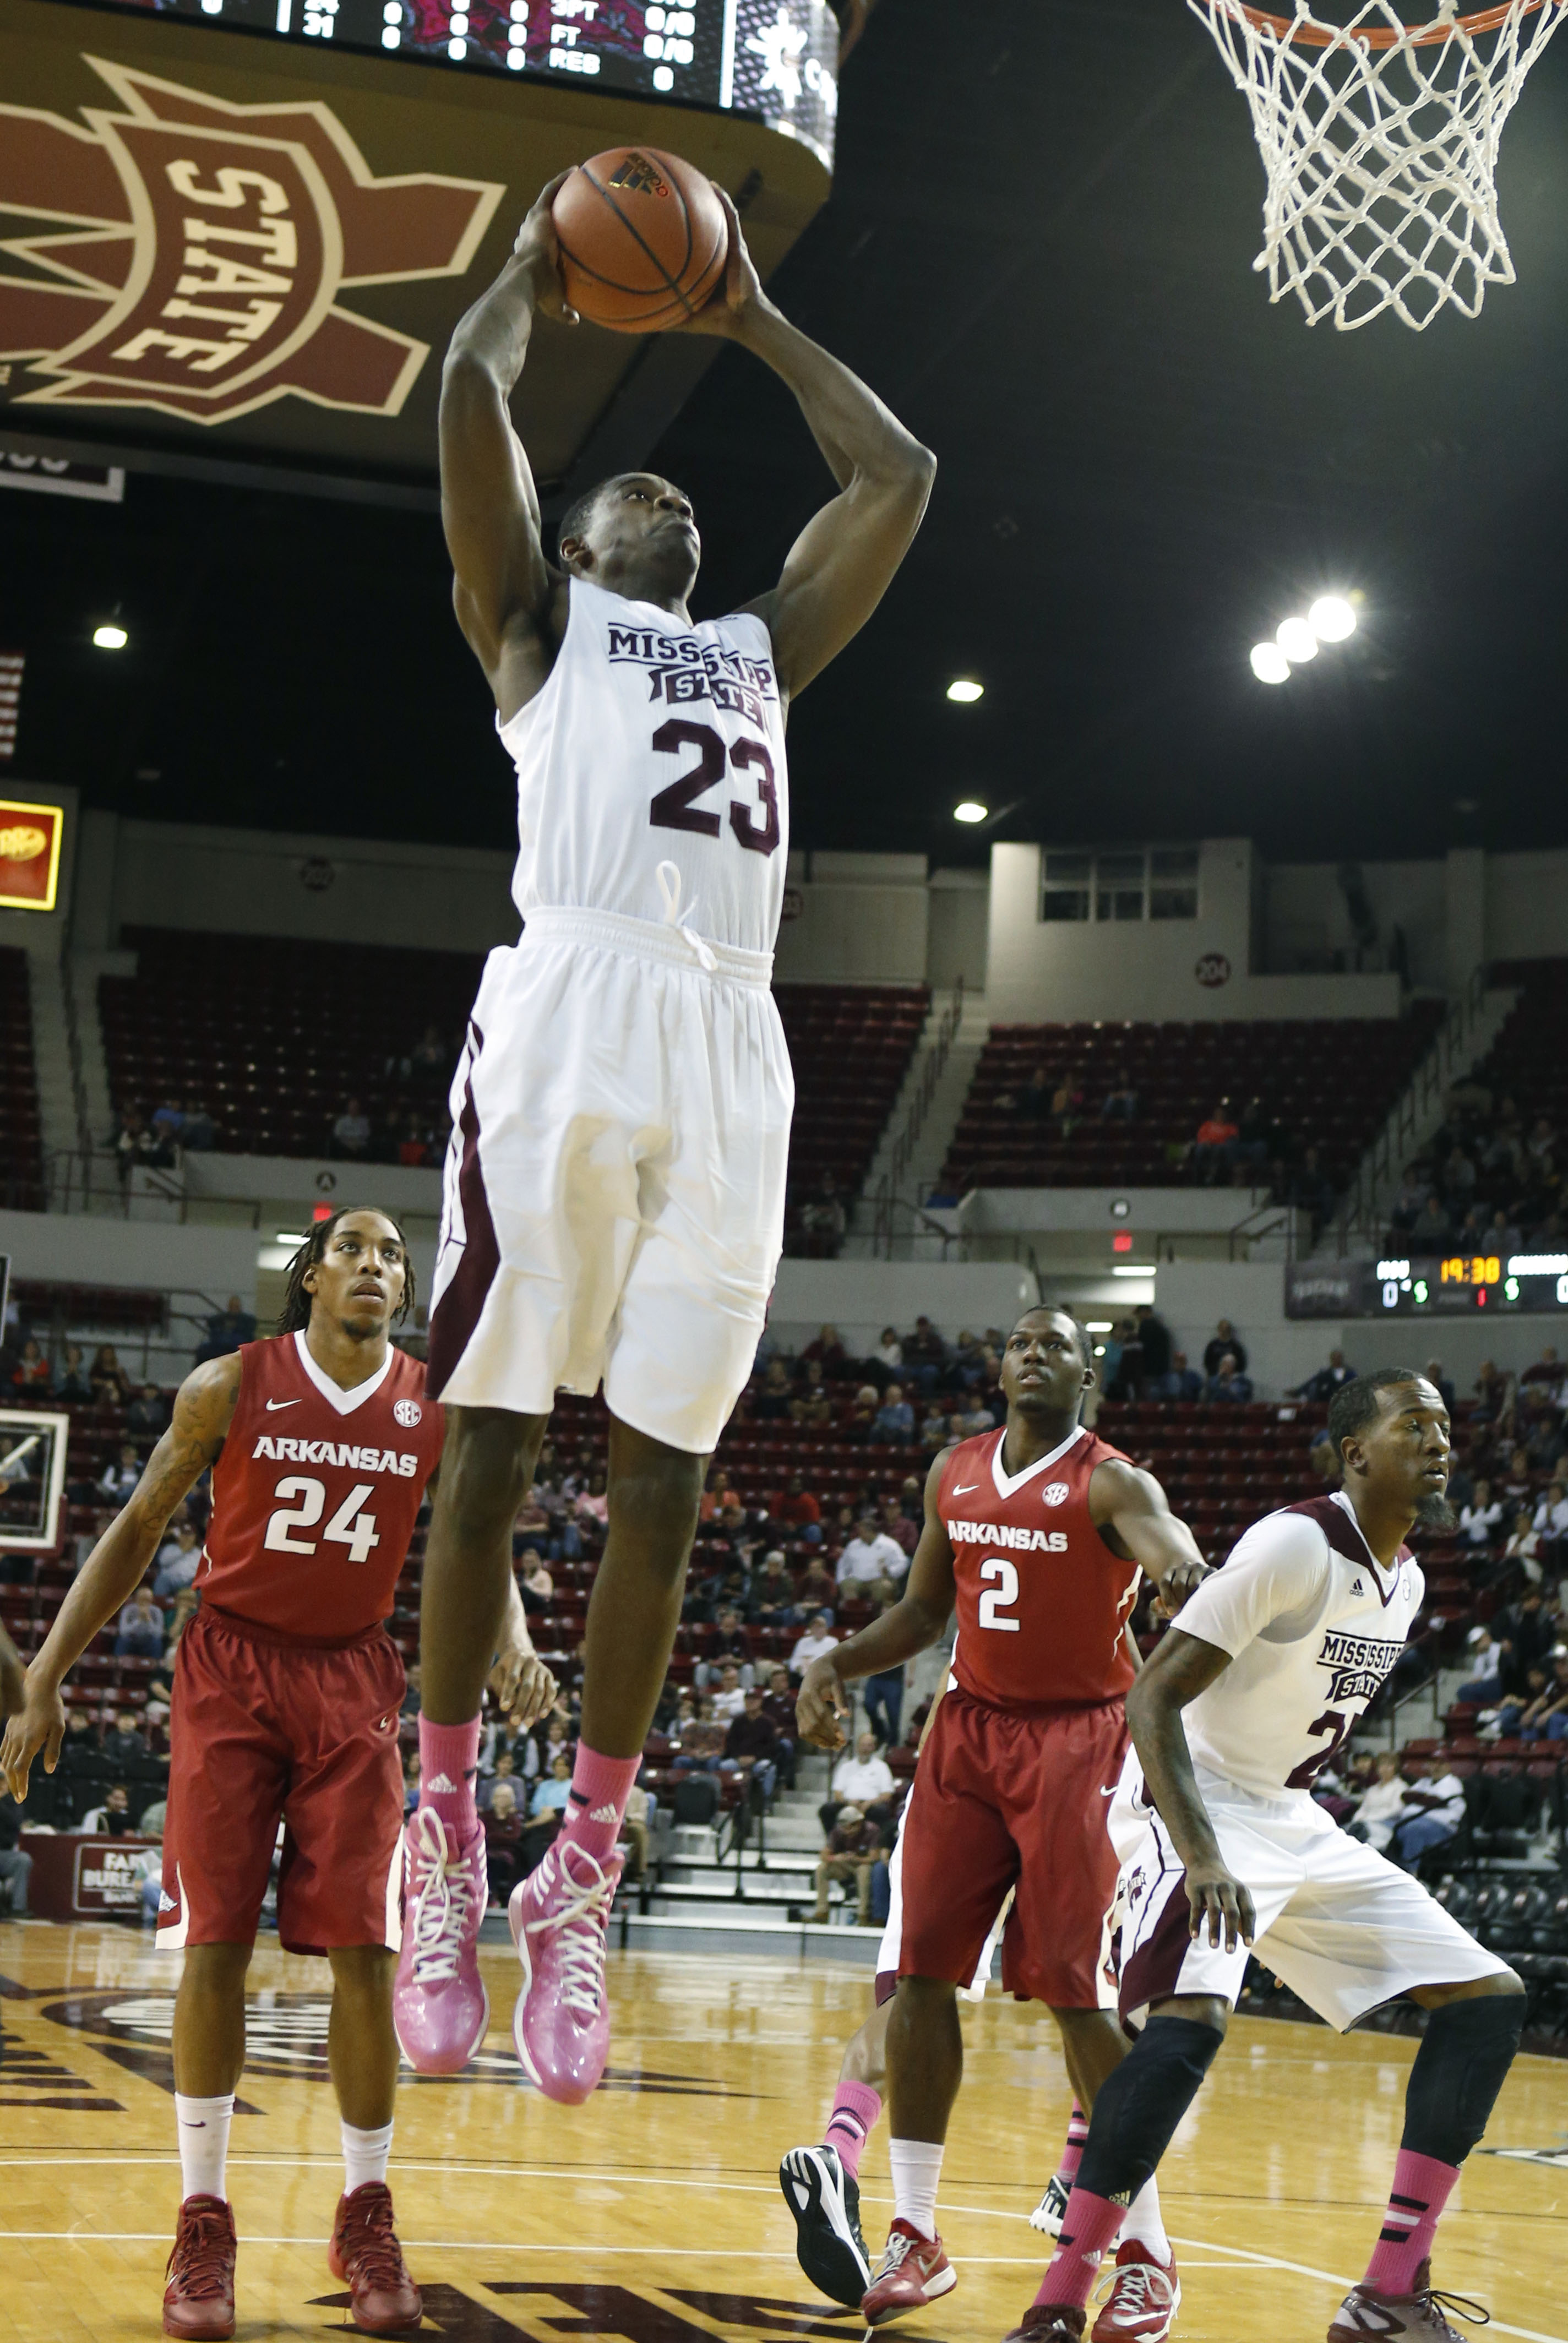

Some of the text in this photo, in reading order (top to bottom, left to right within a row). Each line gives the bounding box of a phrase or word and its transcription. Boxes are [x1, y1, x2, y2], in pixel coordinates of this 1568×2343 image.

[303, 12, 334, 38] 31
[551, 24, 581, 46] FT
[549, 47, 601, 74] REB
[111, 159, 297, 373] STATE
[650, 719, 780, 858] 23
[1441, 1256, 1500, 1284] 19:30
[1382, 1281, 1398, 1307] 0
[395, 1402, 419, 1426] SEC
[252, 1436, 418, 1478] ARKANSAS
[1045, 1483, 1068, 1506] SEC
[264, 1475, 381, 1563] 24
[947, 1519, 1069, 1552] ARKANSAS
[978, 1557, 1021, 1632] 2
[83, 1869, 135, 1887] BURE
